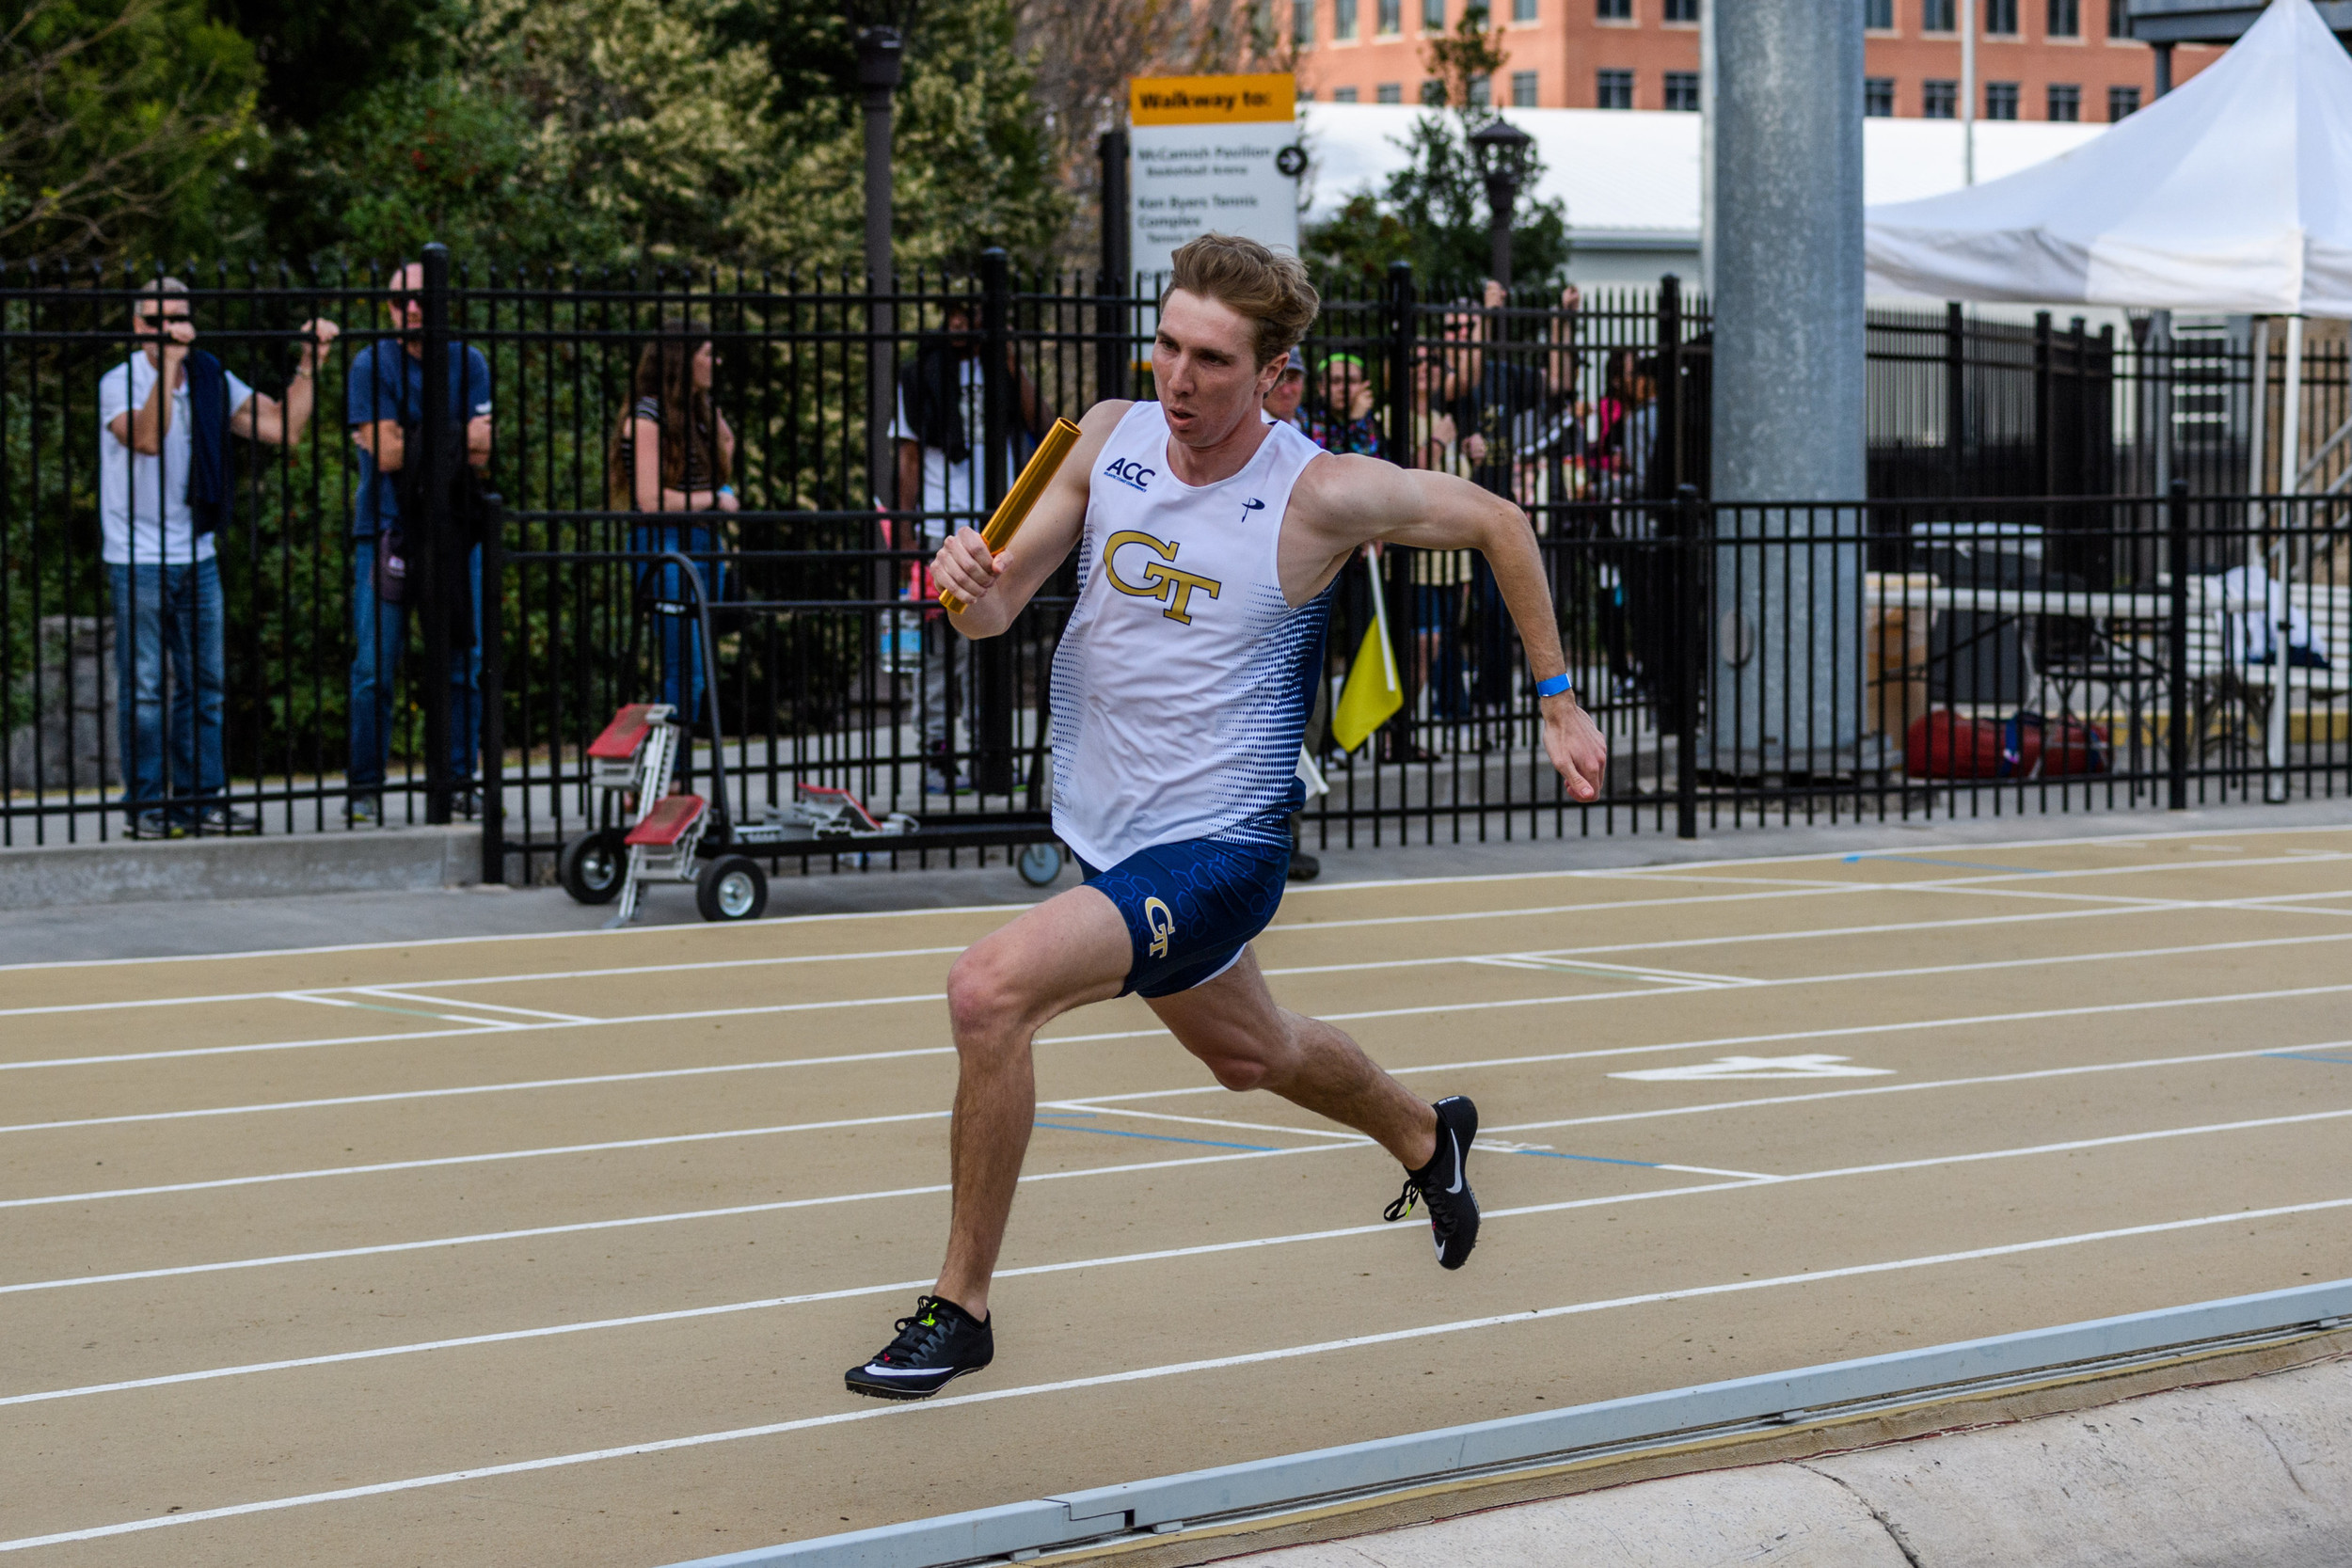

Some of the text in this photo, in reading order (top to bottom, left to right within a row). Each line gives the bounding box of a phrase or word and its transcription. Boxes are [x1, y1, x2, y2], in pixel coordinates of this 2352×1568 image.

[1139, 89, 1271, 111] Walkway to:
[1106, 457, 1156, 487] ACC
[1103, 531, 1222, 626] GT
[1145, 896, 1176, 958] GT
